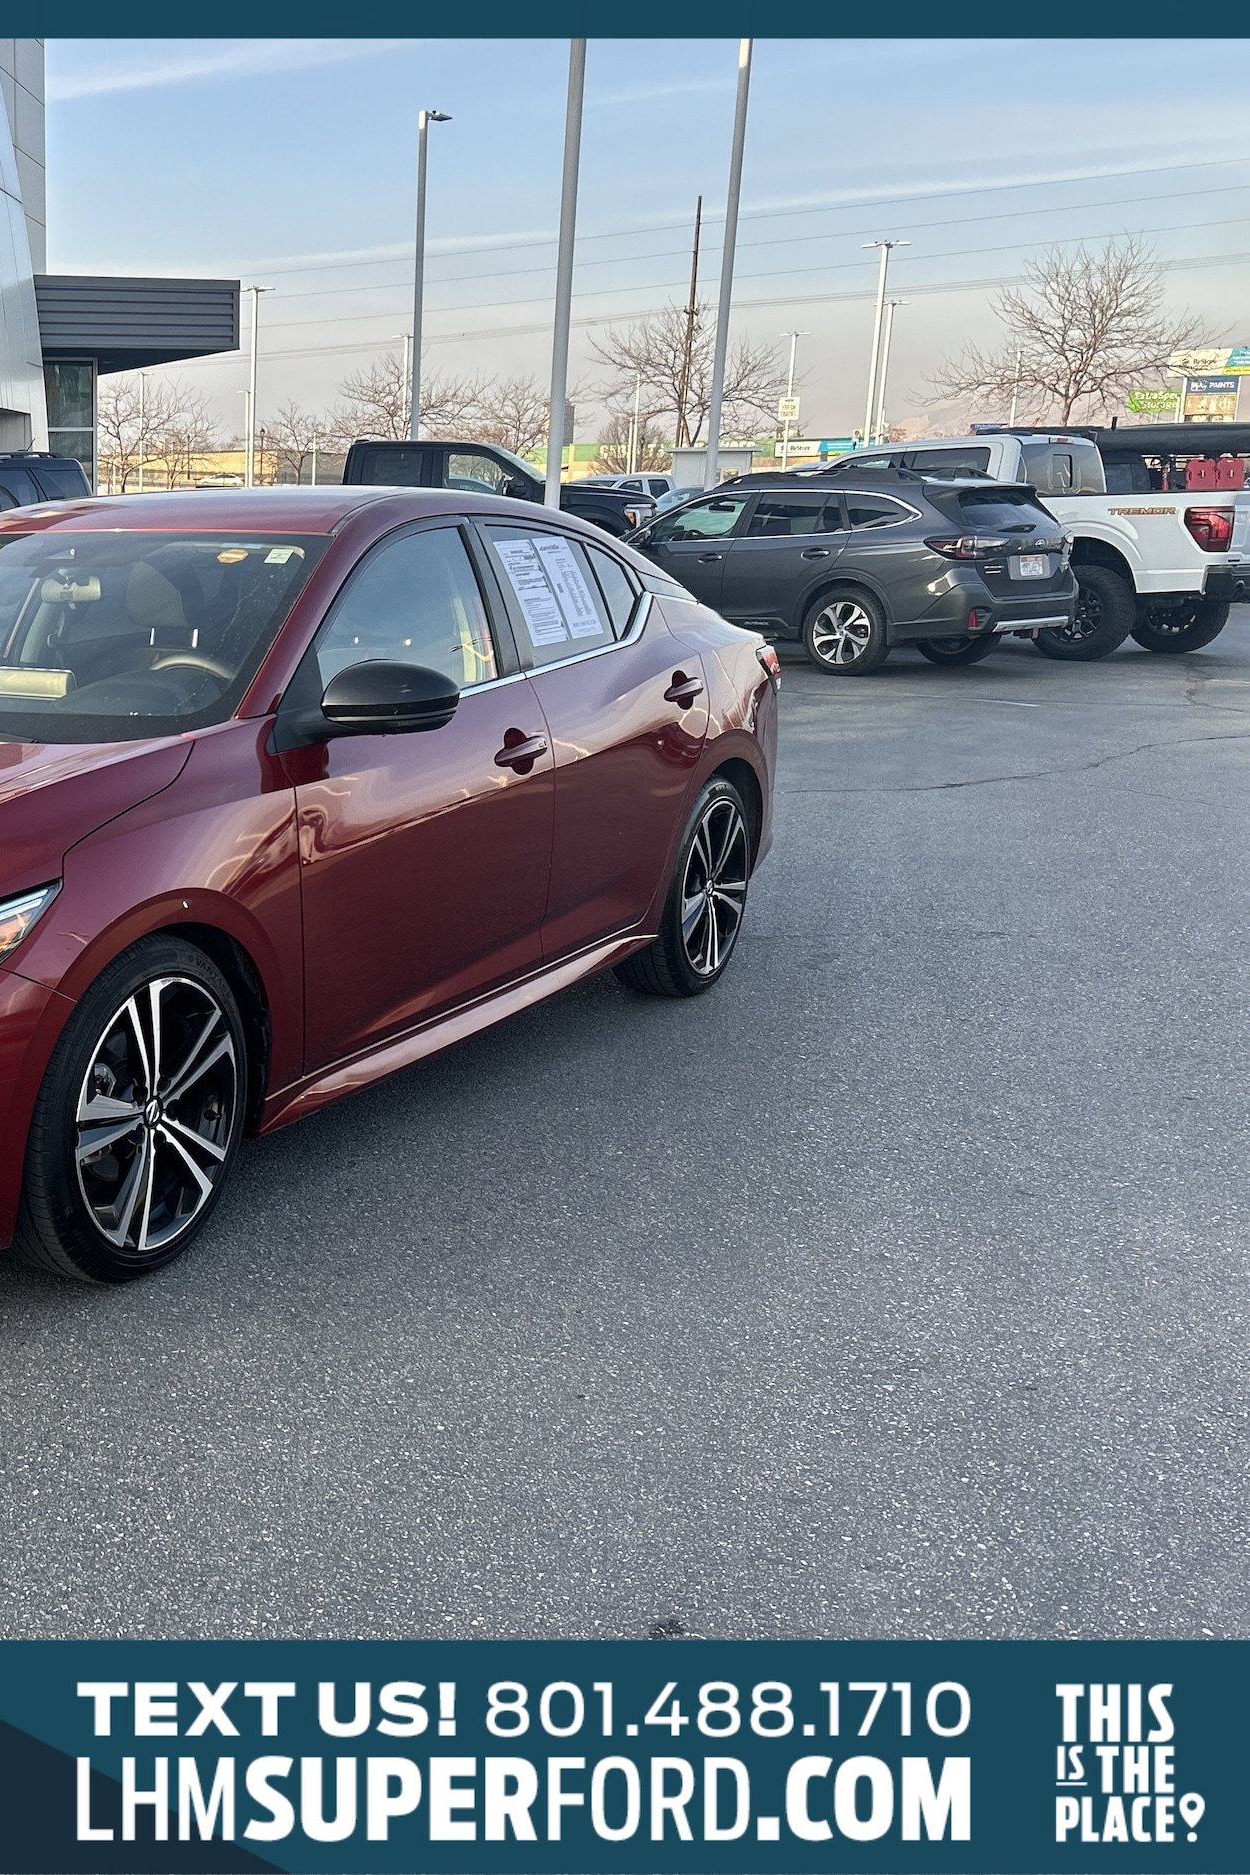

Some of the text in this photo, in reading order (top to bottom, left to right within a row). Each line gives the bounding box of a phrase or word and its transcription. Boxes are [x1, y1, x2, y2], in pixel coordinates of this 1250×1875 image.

[1209, 381, 1235, 389] PAINTS
[1140, 401, 1177, 410] Storage
[1108, 507, 1176, 515] TREMOR
